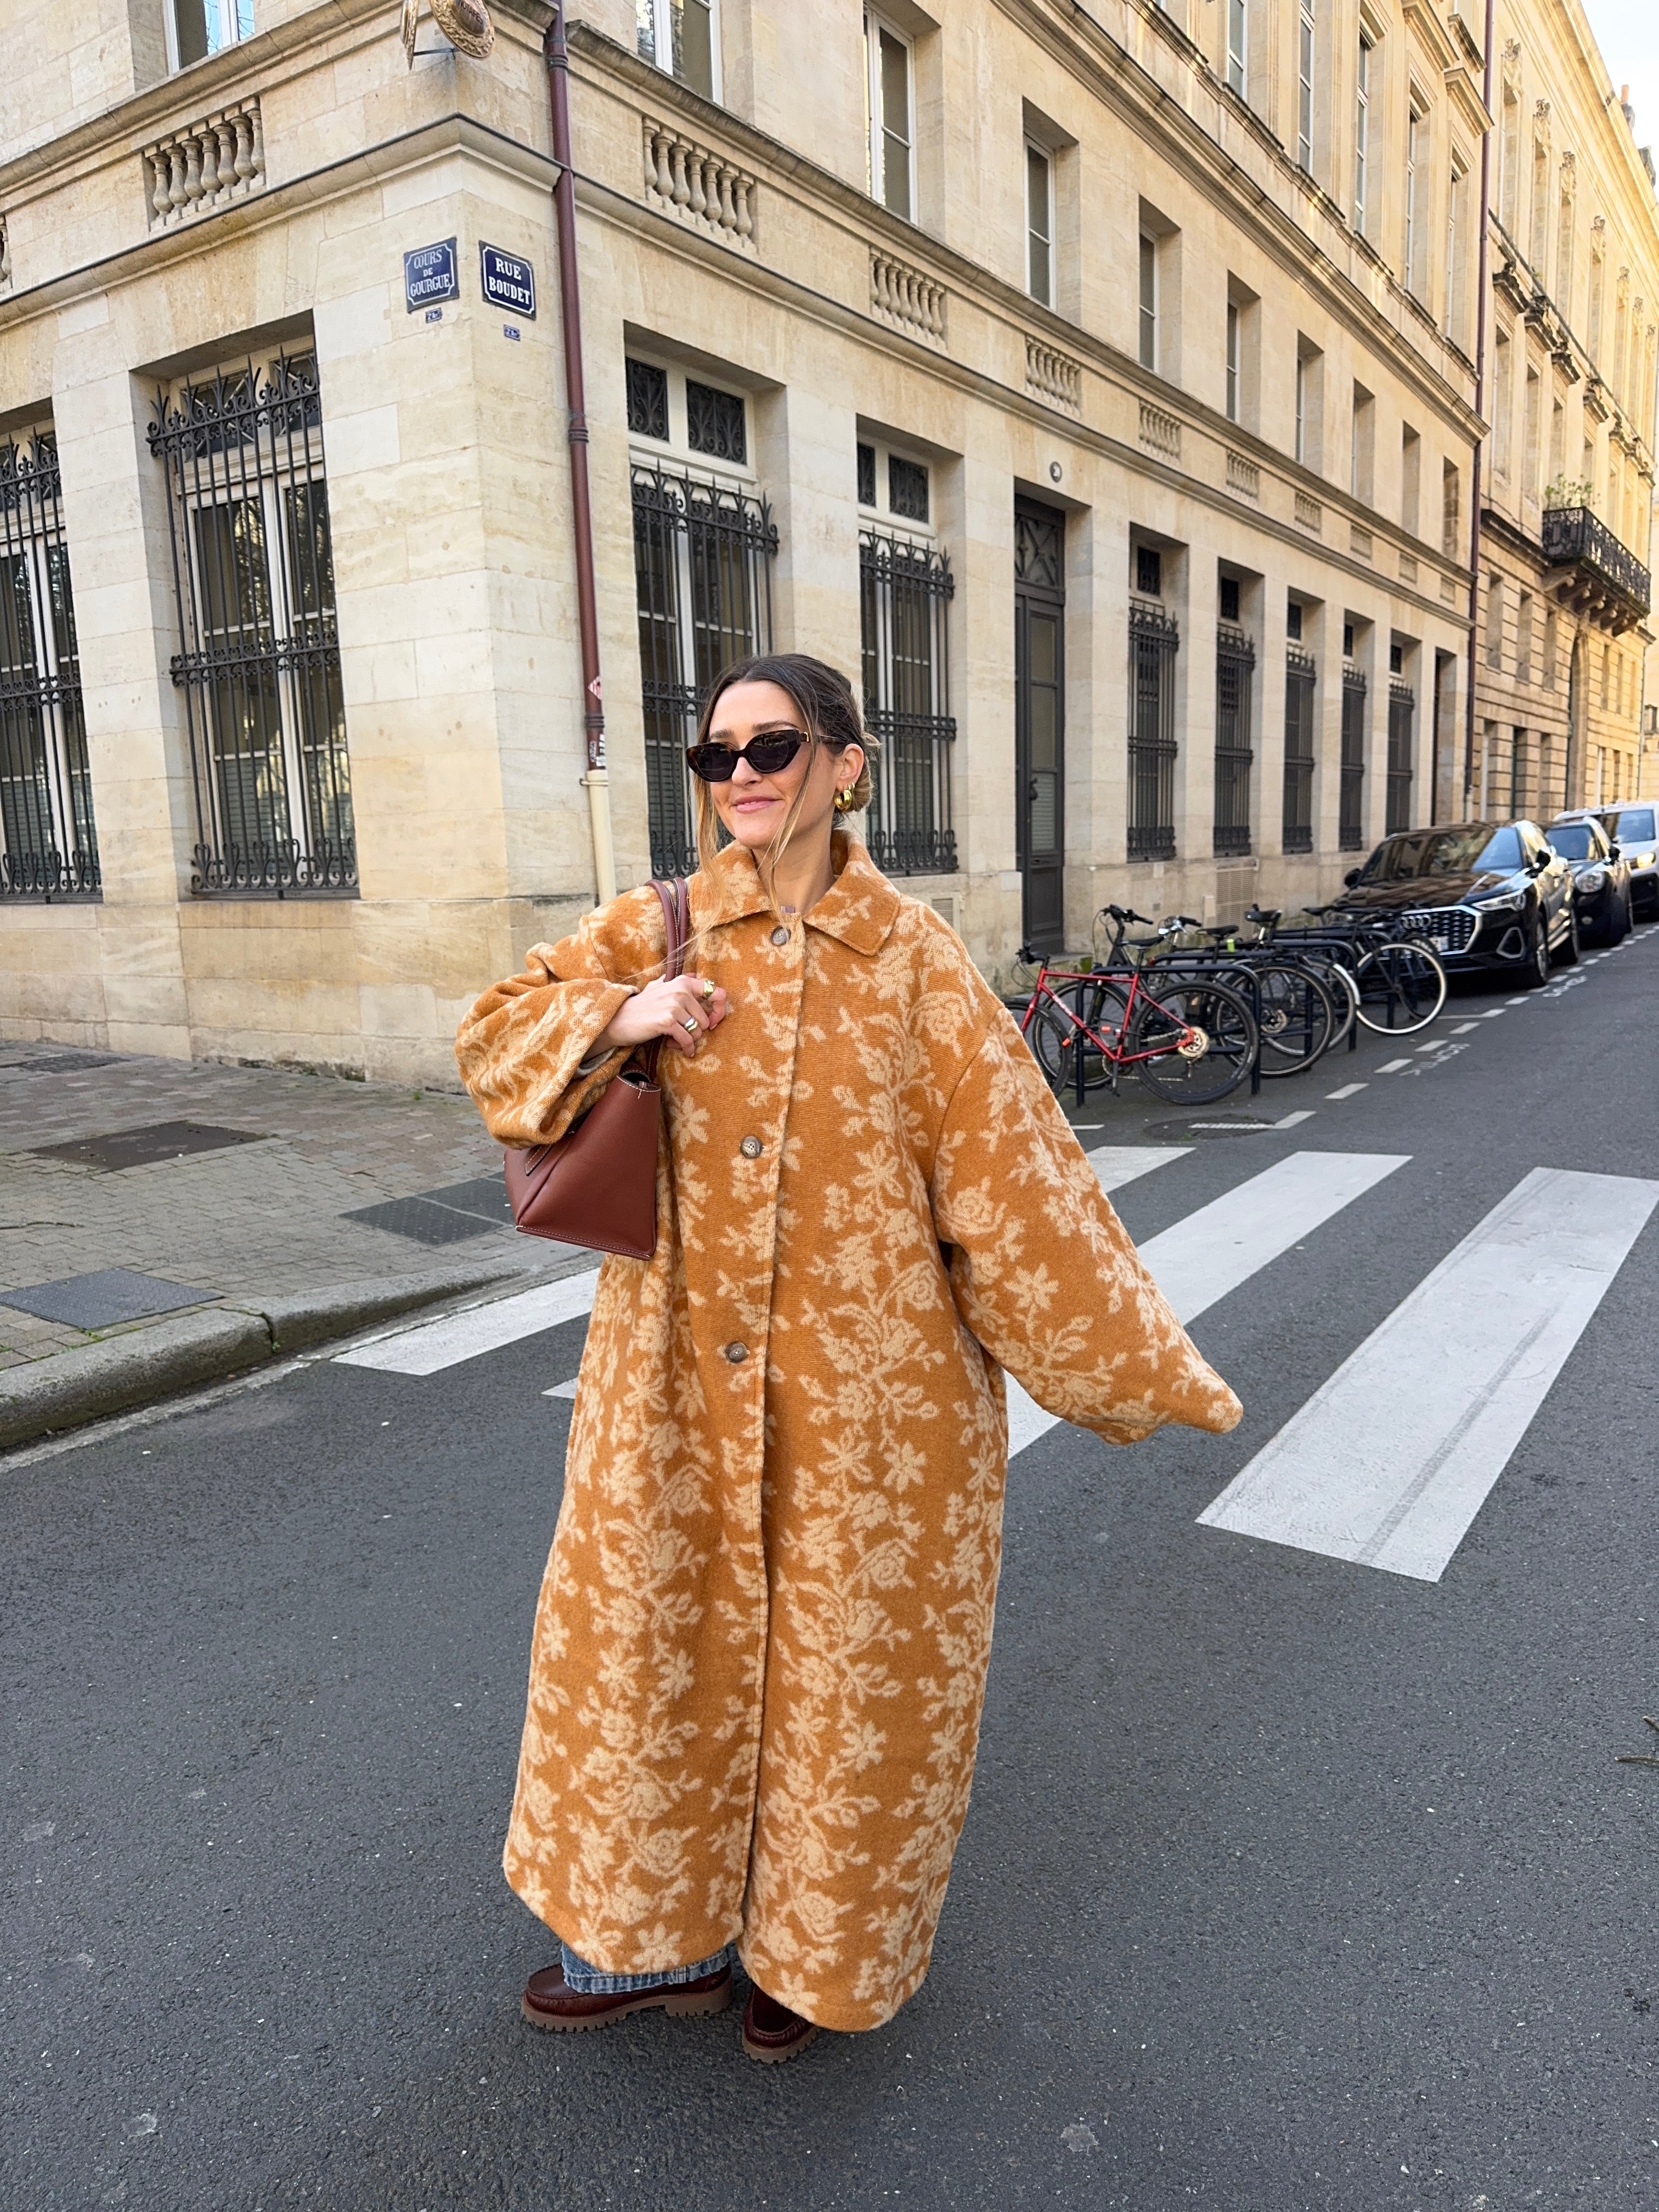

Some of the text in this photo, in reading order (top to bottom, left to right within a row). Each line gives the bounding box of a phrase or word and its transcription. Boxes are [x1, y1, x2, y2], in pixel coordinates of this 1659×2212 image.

[414, 249, 442, 269] COURS
[495, 257, 522, 280] RUE
[423, 267, 433, 277] DE
[410, 273, 450, 297] GOURGUE
[488, 276, 531, 304] BOUDET
